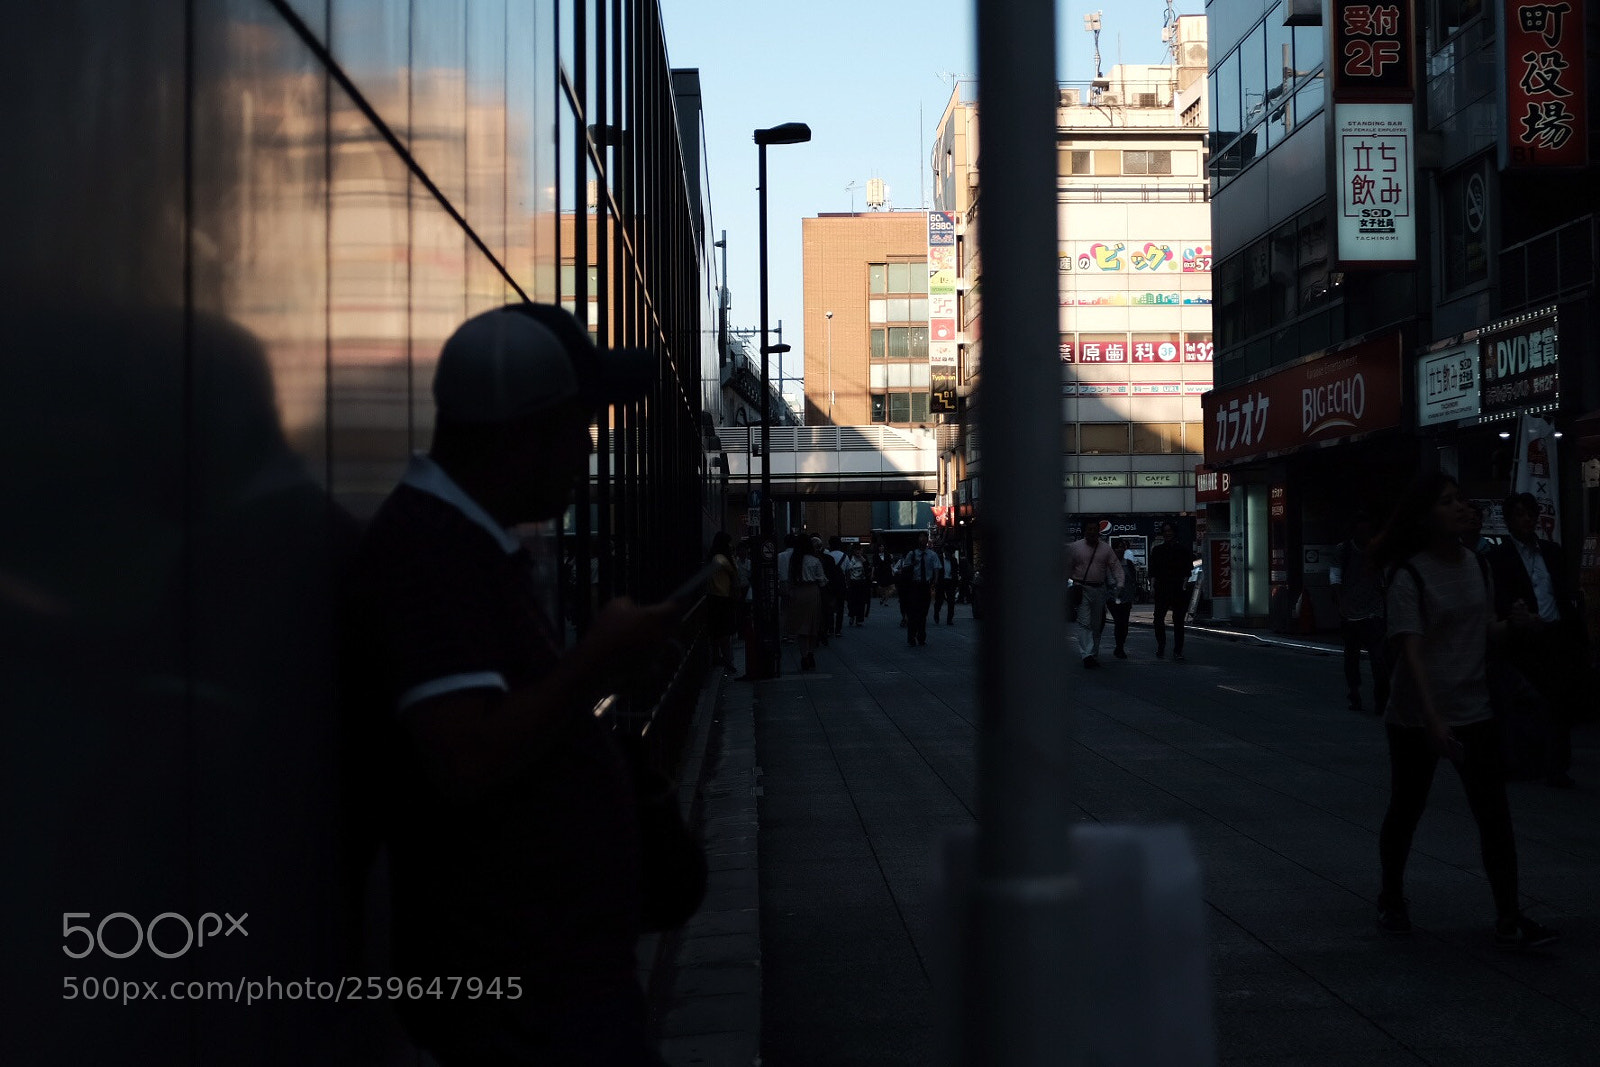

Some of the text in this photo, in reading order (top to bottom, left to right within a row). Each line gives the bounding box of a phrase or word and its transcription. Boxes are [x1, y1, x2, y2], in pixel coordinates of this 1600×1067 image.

[1344, 5, 1399, 36] 受付
[1344, 40, 1400, 77] 2F
[1518, 1, 1577, 150] 町役場
[1353, 141, 1396, 172] 立ち
[1513, 145, 1535, 162] B1
[1352, 174, 1402, 205] 飲み
[1360, 218, 1394, 228] 女子社員
[1161, 347, 1173, 356] 3F
[1302, 373, 1365, 433] BIG ECHO
[1216, 392, 1270, 452] カラオケ
[1113, 523, 1137, 532] pepsi
